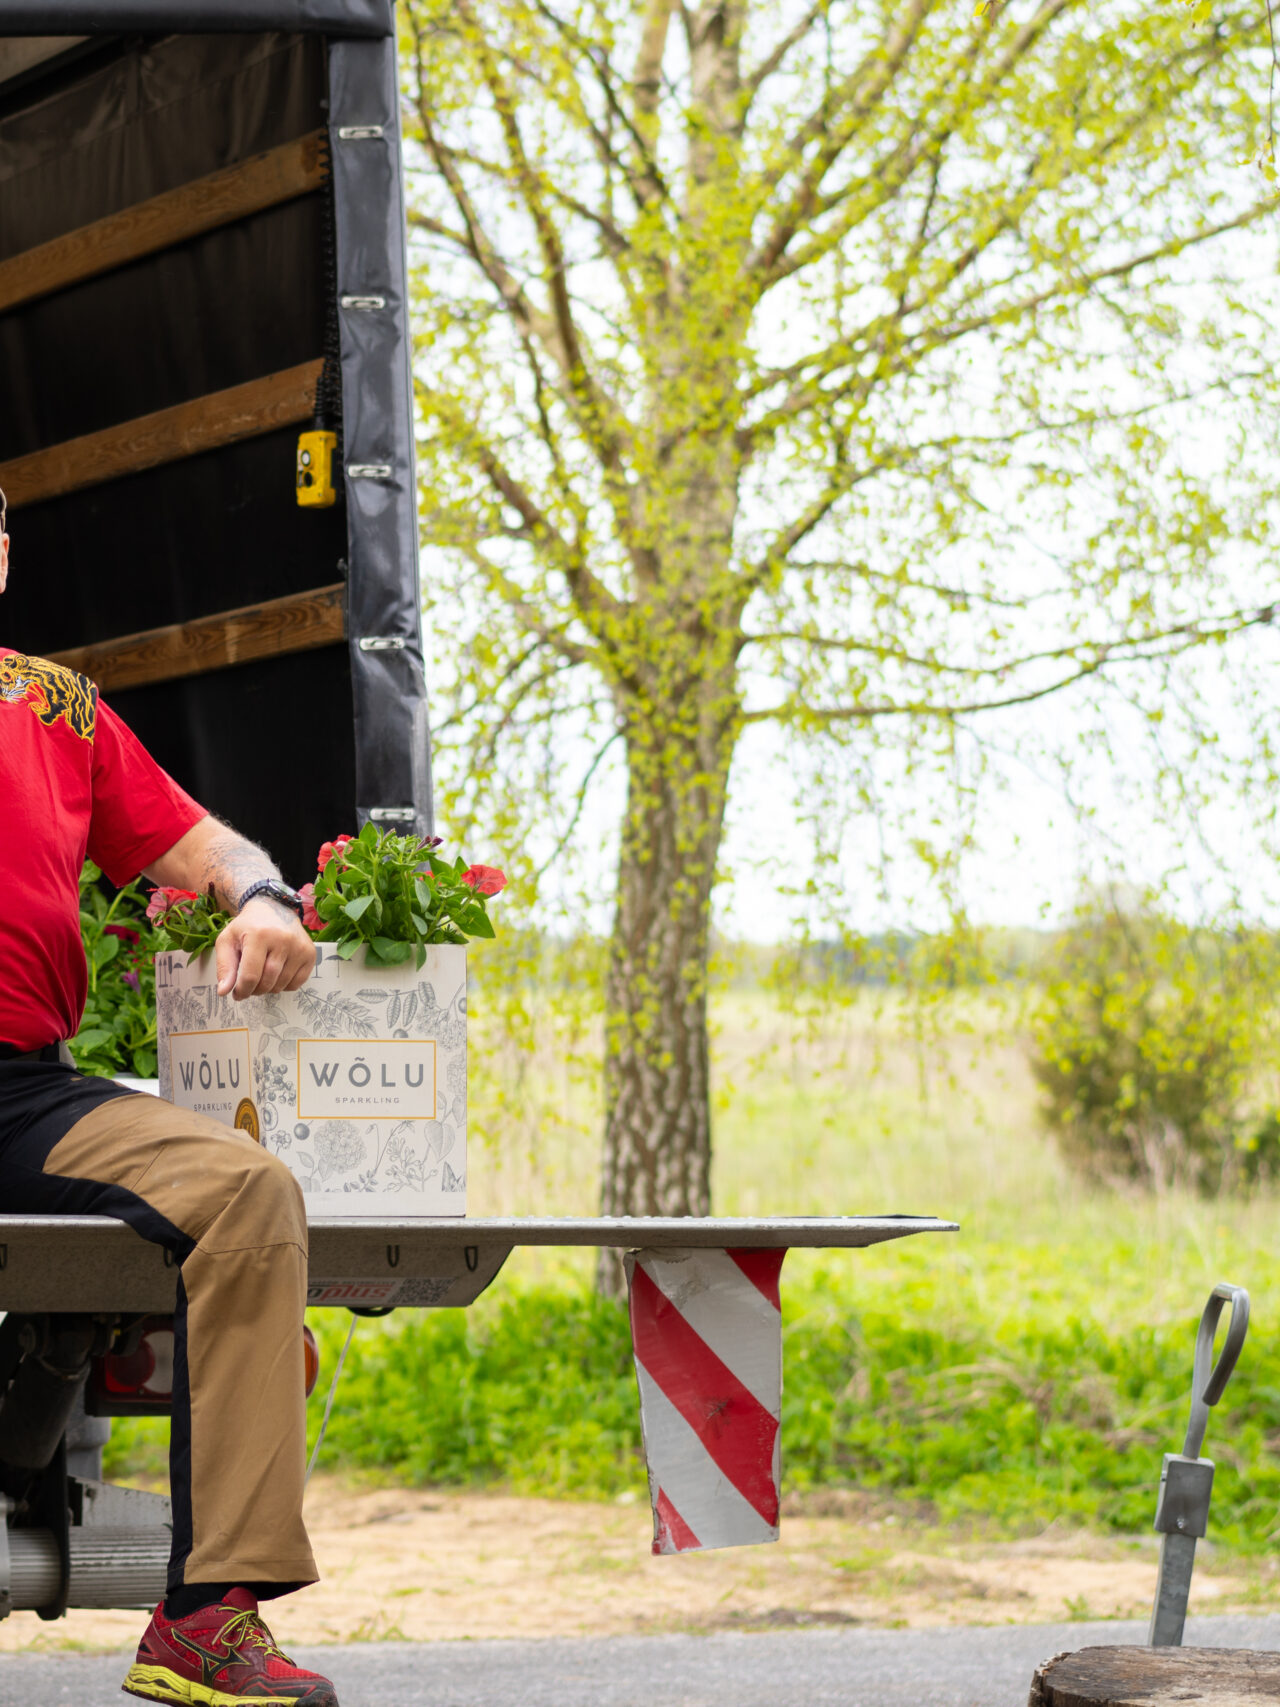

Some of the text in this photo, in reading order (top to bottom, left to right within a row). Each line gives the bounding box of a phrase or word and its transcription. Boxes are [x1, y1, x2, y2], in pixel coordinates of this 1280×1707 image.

[179, 1053, 240, 1091] WÕLU
[309, 1057, 424, 1088] WÕLU
[193, 1102, 233, 1112] SPARKLING
